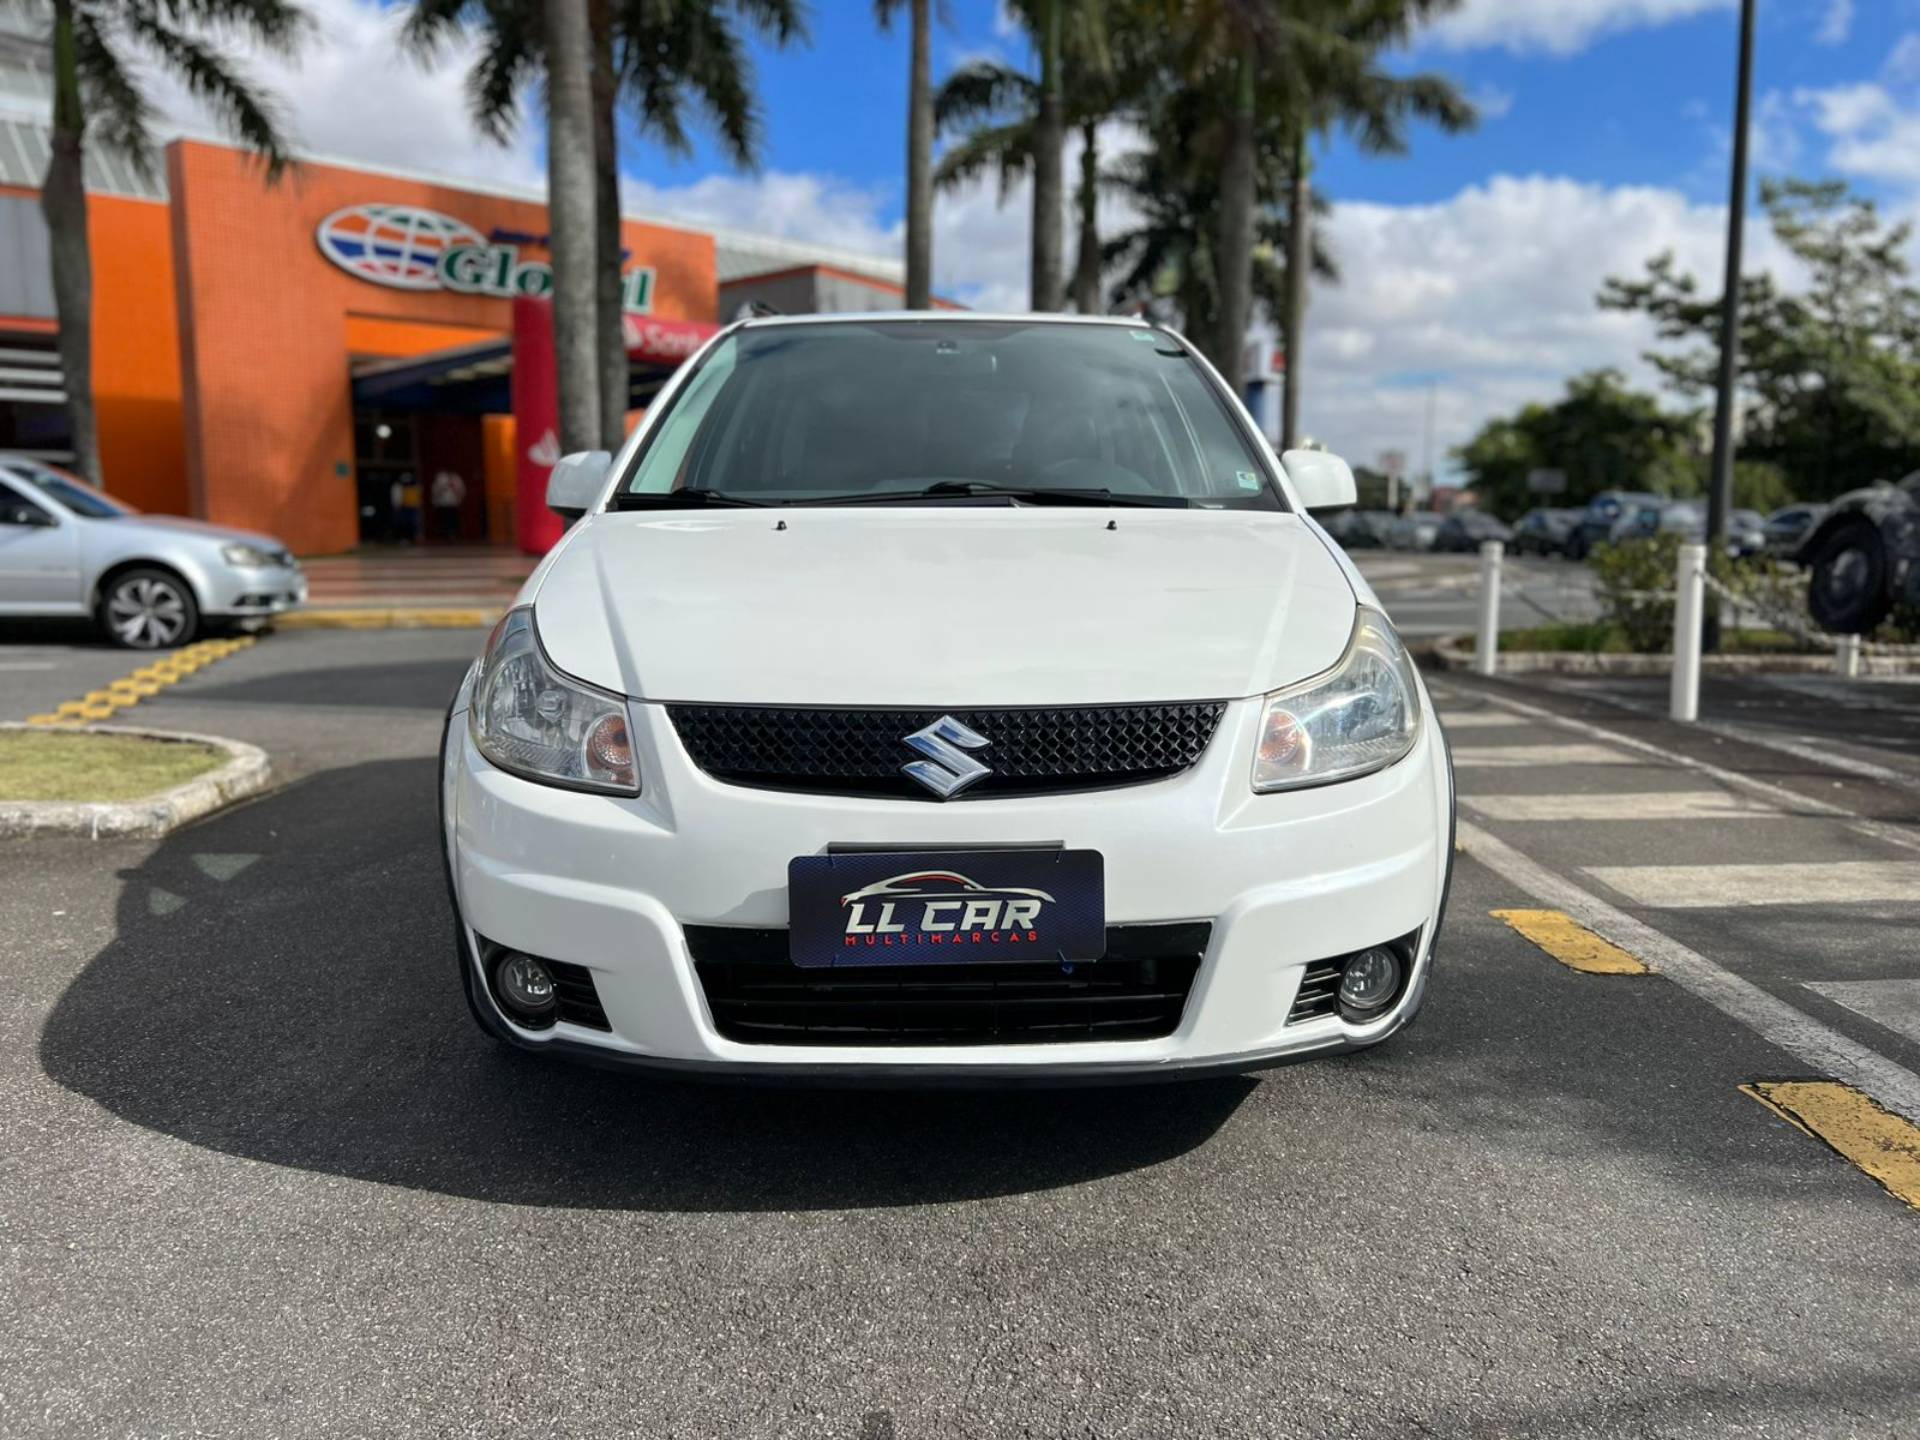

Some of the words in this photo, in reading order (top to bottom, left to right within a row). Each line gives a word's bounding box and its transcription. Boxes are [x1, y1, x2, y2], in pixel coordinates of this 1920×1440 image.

[440, 245, 654, 312] Glol
[845, 902, 905, 933] LL
[920, 899, 1041, 931] CAR
[844, 930, 1037, 946] MULTIMARCAS
